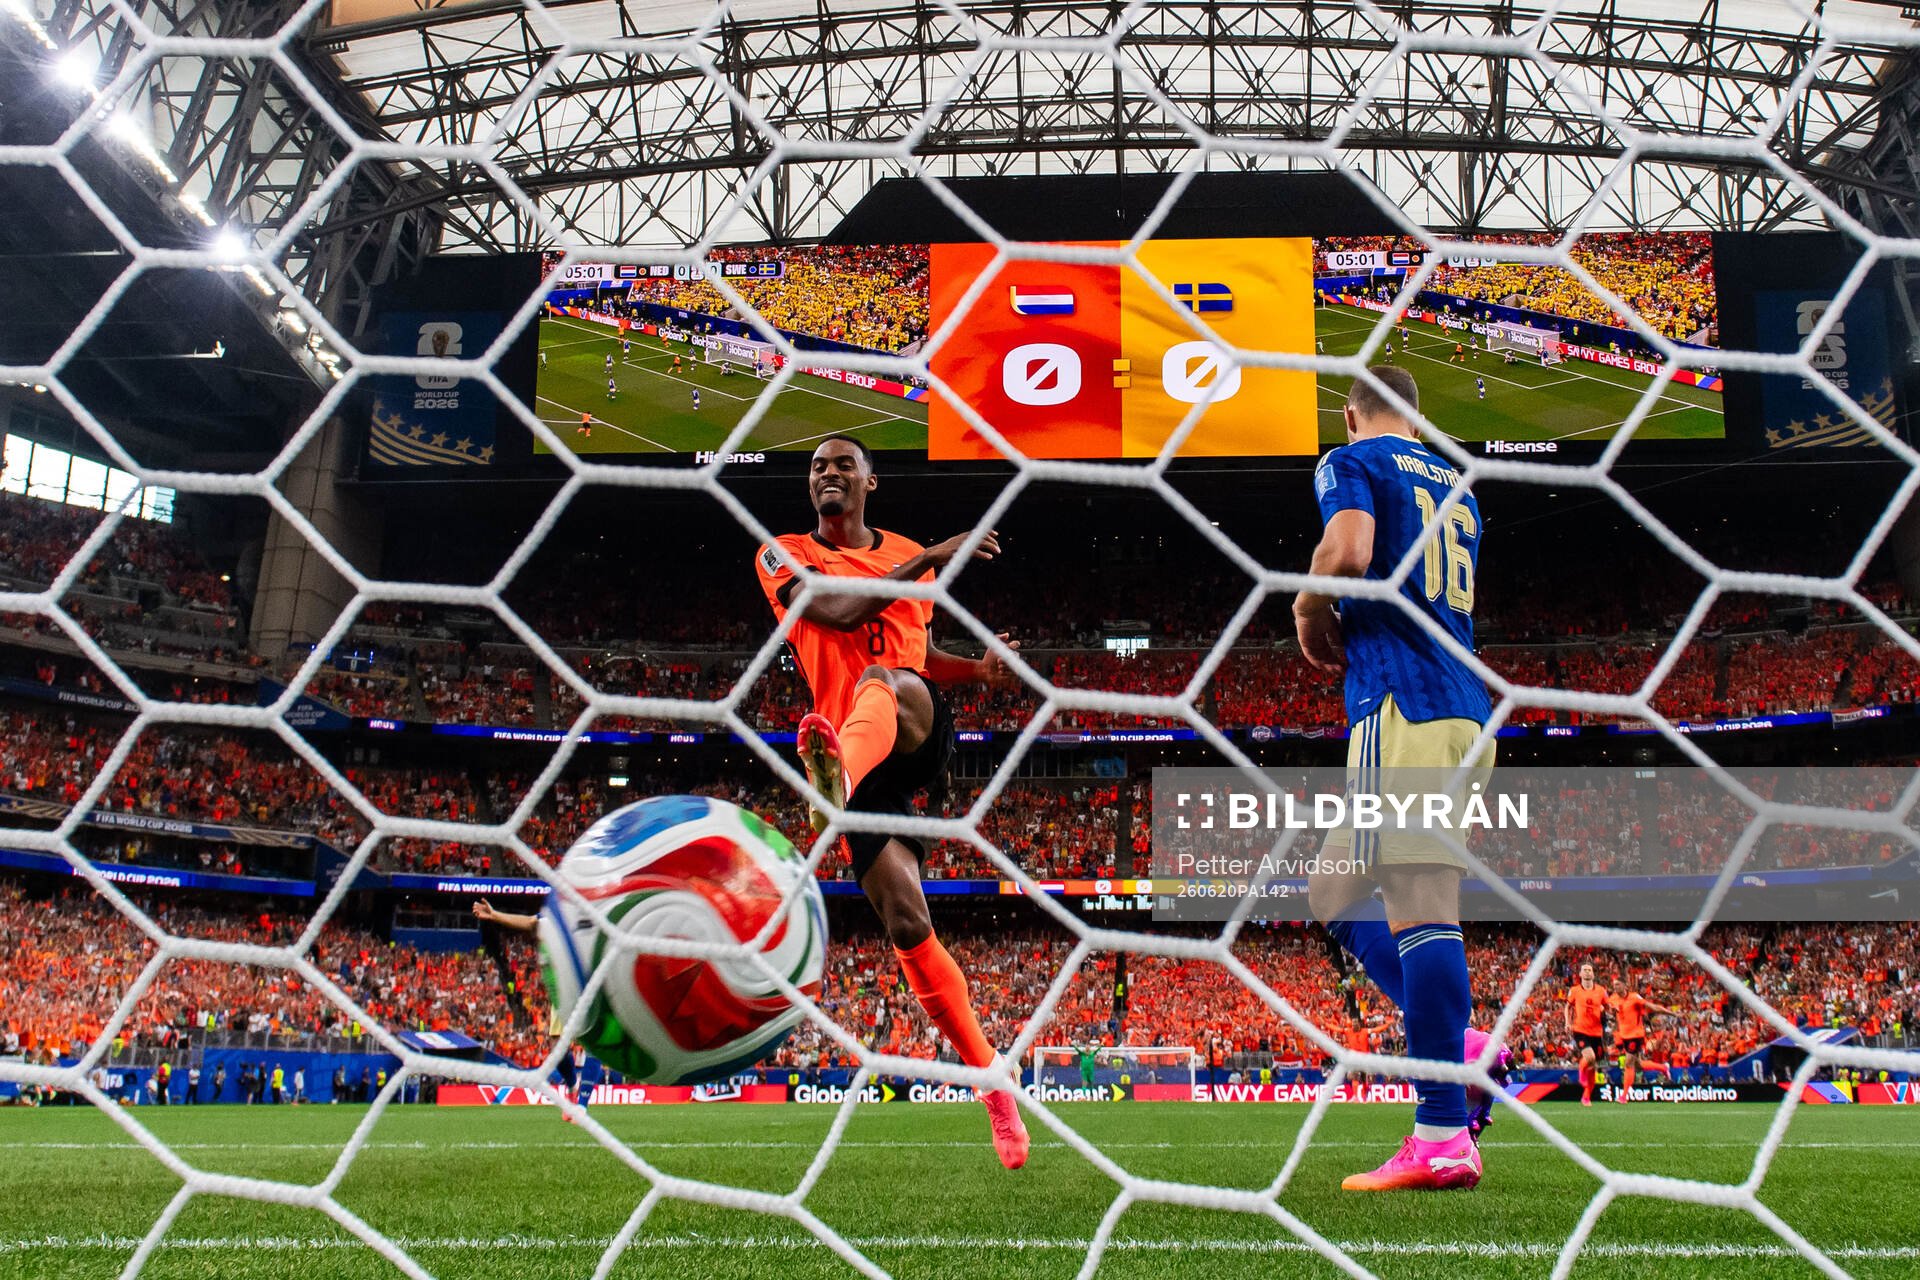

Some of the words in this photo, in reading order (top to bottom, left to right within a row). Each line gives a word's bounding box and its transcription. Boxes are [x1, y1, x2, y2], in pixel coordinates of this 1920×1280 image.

[1336, 254, 1375, 266] 05:01
[565, 266, 603, 279] 05:01
[650, 265, 669, 277] NED
[678, 266, 686, 276] 0
[725, 264, 747, 275] SWE
[1599, 354, 1630, 369] GAMES
[1813, 355, 1834, 363] FIFA
[812, 367, 842, 381] GAMES
[846, 371, 877, 389] GROUP
[1802, 379, 1849, 389] 26
[414, 399, 459, 409] 2026
[1485, 440, 1557, 453] Hisense
[1413, 486, 1477, 616] 16
[867, 618, 885, 656] 8
[58, 691, 76, 702] FIFA
[77, 695, 105, 707] WORLD
[106, 700, 122, 709] CUP
[493, 731, 512, 740] FIFA
[513, 733, 543, 741] WORLD
[95, 814, 115, 824] FIFA
[116, 816, 146, 828] WORLD
[147, 820, 163, 830] CUP
[97, 870, 126, 881] ORLD
[126, 873, 146, 884] CUP
[438, 882, 460, 892] FIFA
[462, 884, 501, 893] WORLD
[502, 885, 524, 893] CUP
[525, 886, 552, 894] 202
[1652, 1085, 1738, 1103] Rapidísimo
